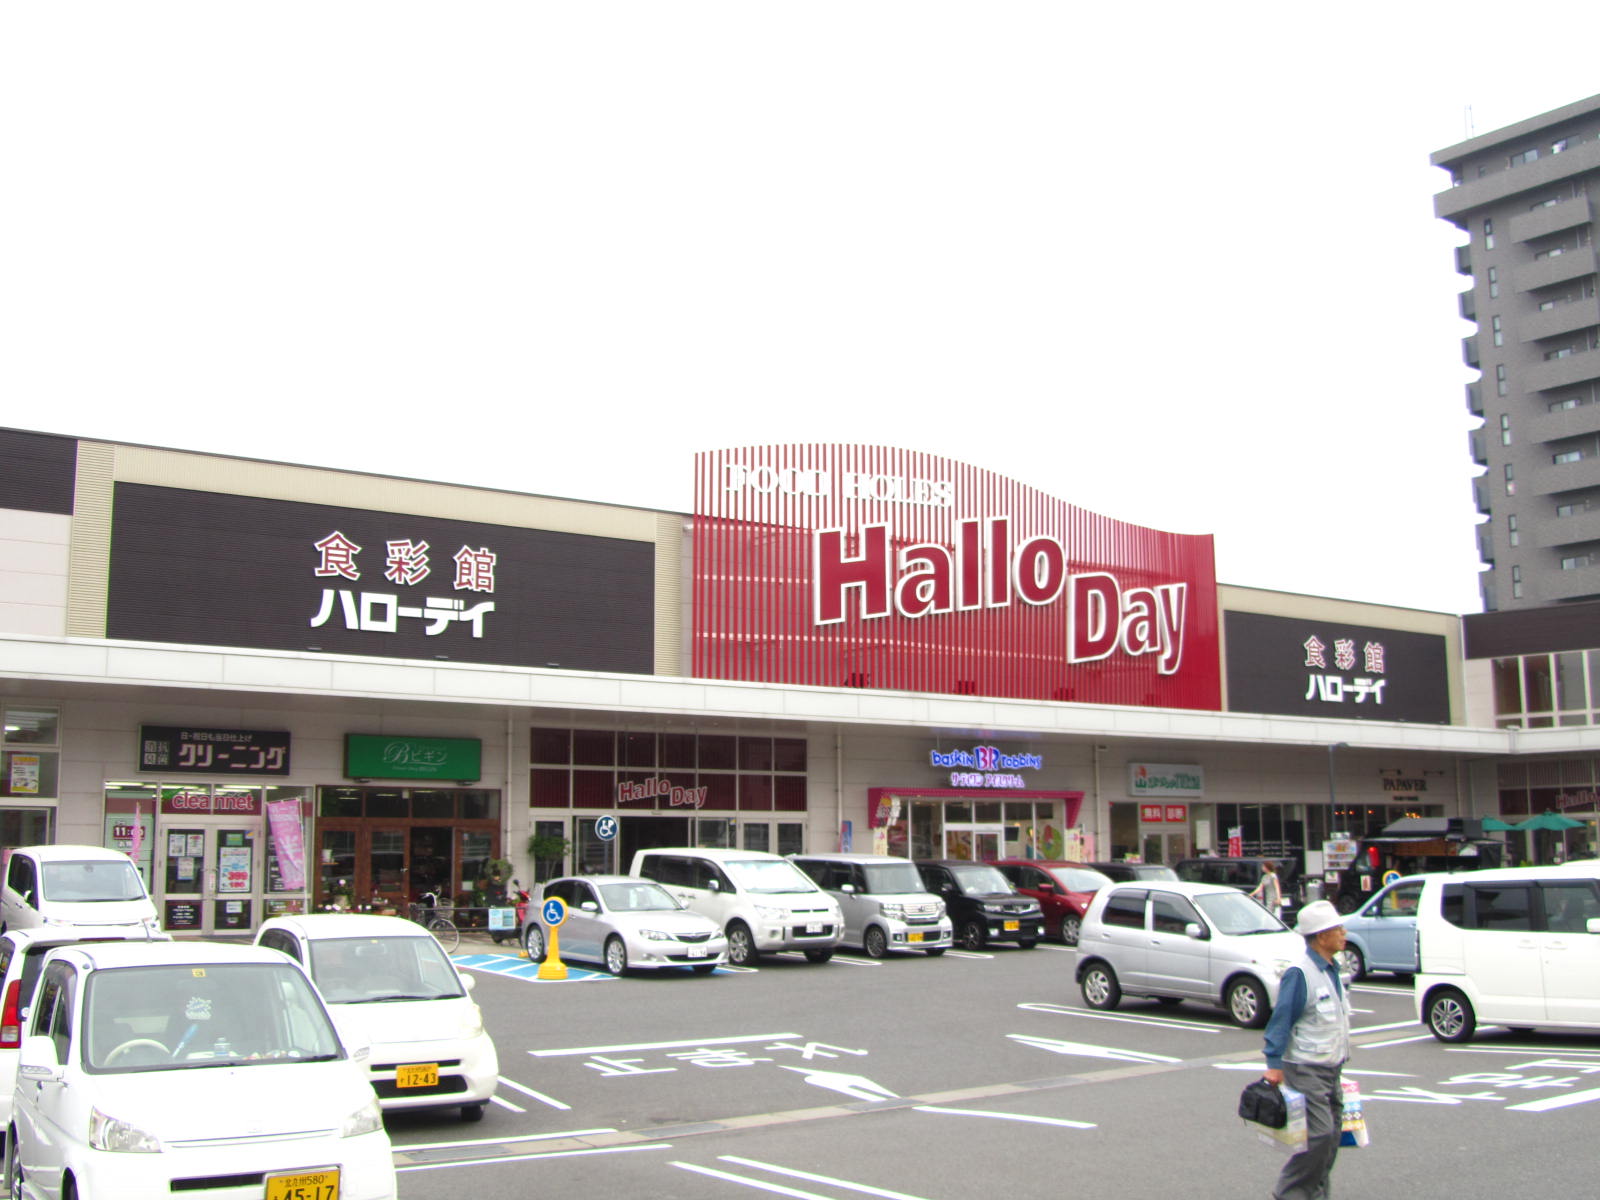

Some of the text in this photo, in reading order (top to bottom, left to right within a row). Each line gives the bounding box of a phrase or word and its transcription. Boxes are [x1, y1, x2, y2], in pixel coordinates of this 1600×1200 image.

[725, 464, 828, 497] FOOD
[313, 530, 497, 593] 食彩館
[813, 516, 1067, 626] Hallo
[310, 588, 496, 639] ハローデイ
[1067, 571, 1187, 676] Day
[1303, 635, 1385, 674] 食彩館
[1304, 674, 1386, 705] ハローデイ
[178, 743, 287, 769] クリーニング
[931, 748, 975, 768] baskin
[1000, 752, 1043, 770] robbins
[618, 776, 671, 803] Hallo
[669, 785, 708, 809] Day
